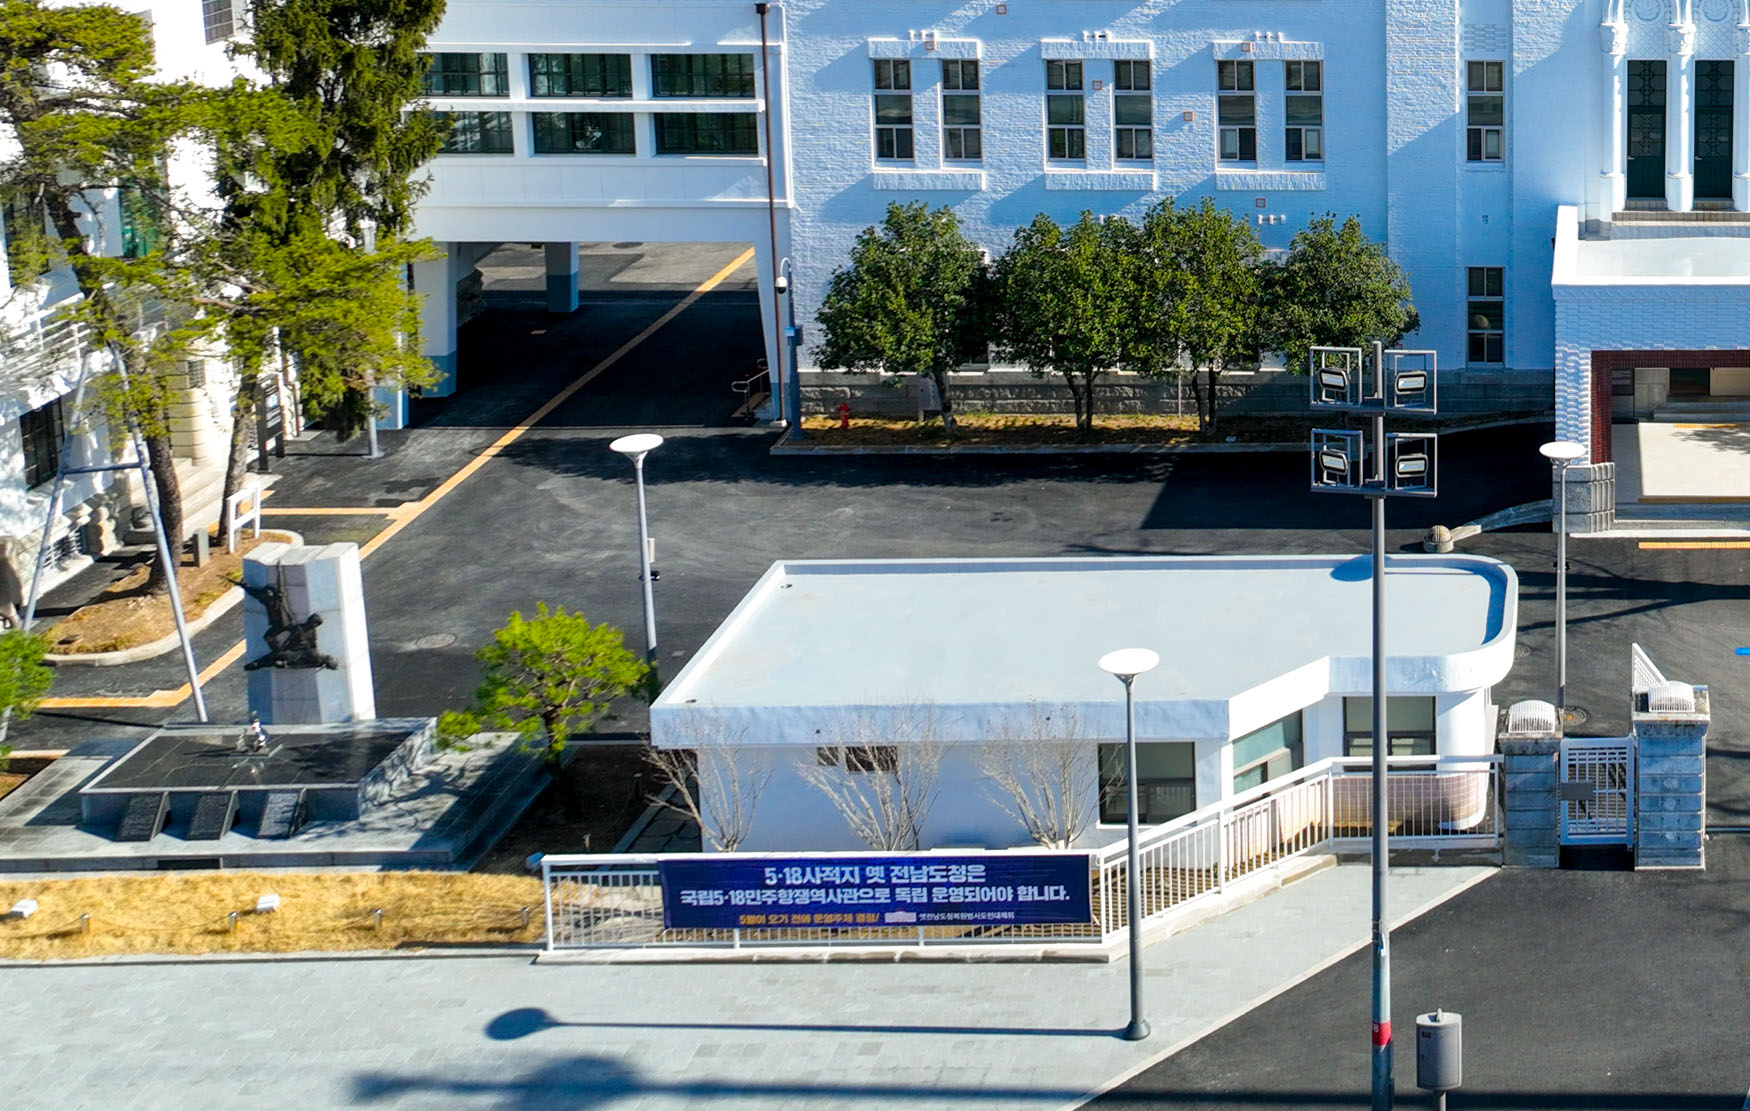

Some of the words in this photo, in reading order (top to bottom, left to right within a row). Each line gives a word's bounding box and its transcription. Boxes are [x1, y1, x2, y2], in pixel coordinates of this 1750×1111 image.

[865, 865, 886, 884] 옛
[890, 864, 987, 884] 전남도청은
[895, 888, 928, 903] 독립
[932, 887, 1014, 903] 운영되어야
[1017, 885, 1071, 902] 합니다.
